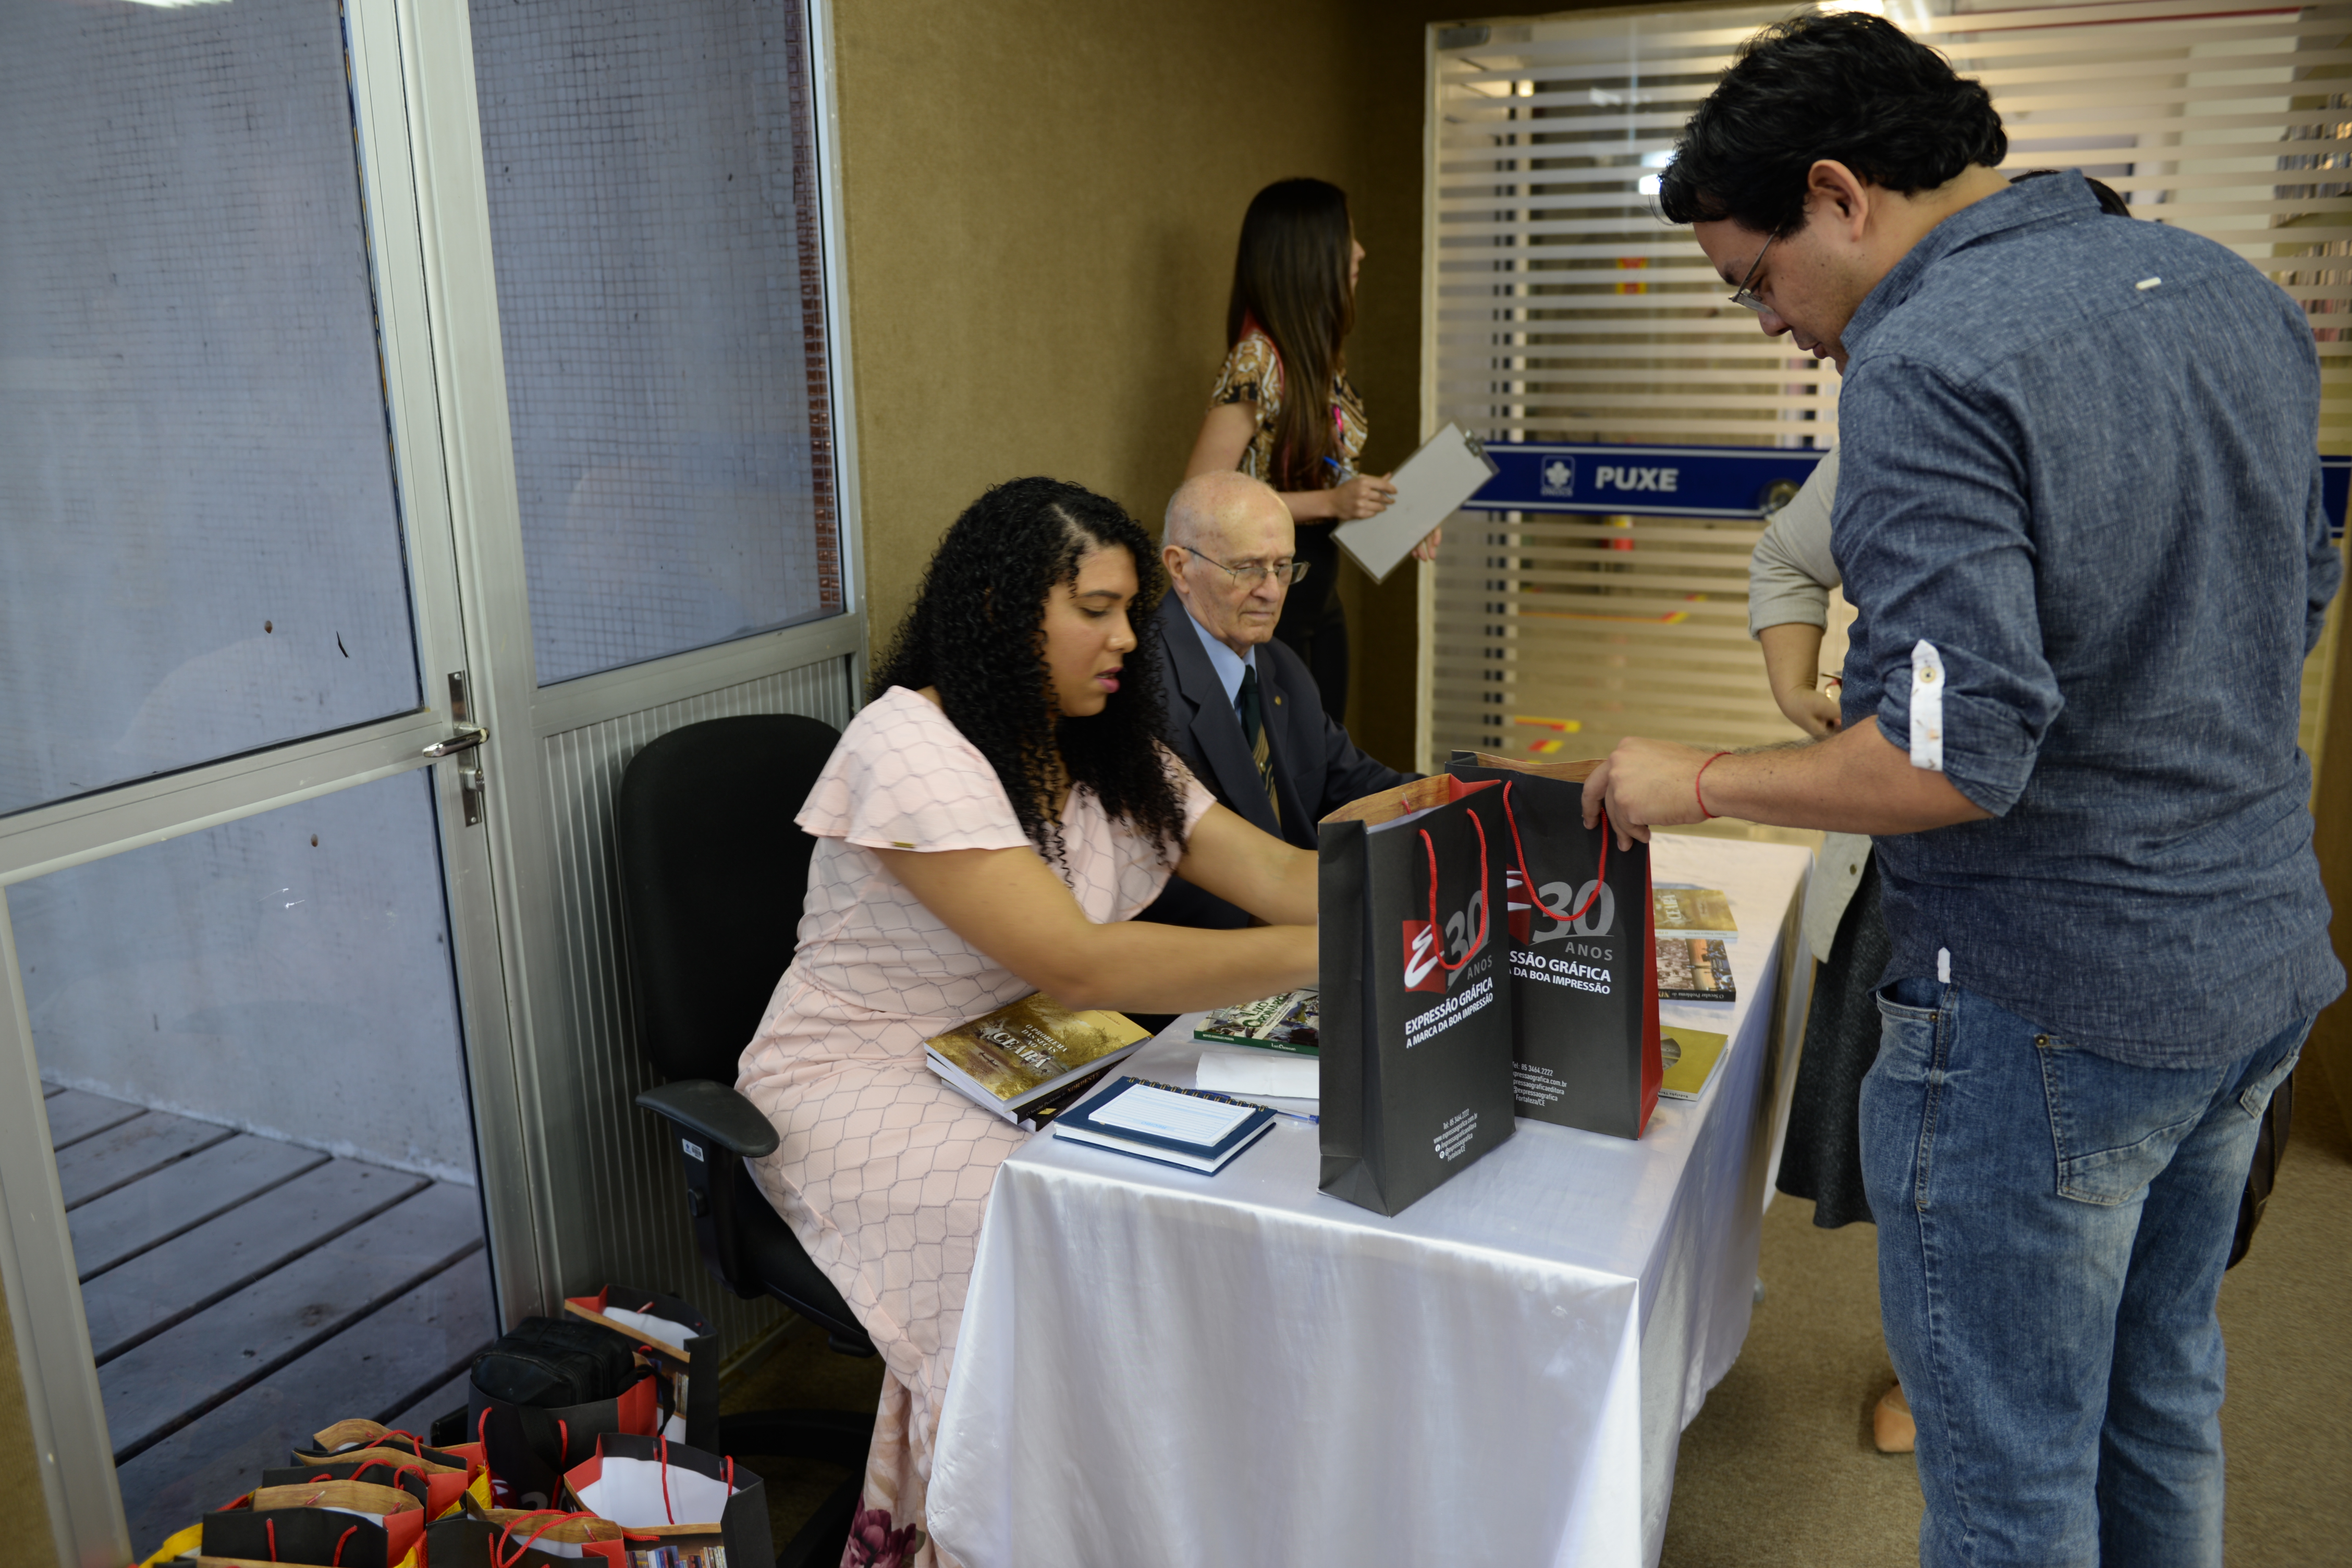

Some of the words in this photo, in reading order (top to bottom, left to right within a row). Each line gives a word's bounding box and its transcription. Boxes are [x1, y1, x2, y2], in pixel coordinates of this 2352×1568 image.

[1595, 465, 1679, 492] PUXE
[1532, 879, 1615, 942] 30
[1445, 890, 1490, 986] 30
[1565, 941, 1613, 961] ANOS
[1467, 955, 1492, 981] ANOS
[1513, 966, 1528, 978] DA
[1529, 970, 1551, 983] BOA
[1552, 975, 1610, 995] IMPRESSÃO
[1549, 959, 1611, 982] GRÁFICA
[1405, 998, 1459, 1035] EXPRESSÃO
[1459, 976, 1493, 1006] GRÁFICA
[1406, 1038, 1413, 1049] A
[1413, 1025, 1438, 1045] MARCA
[1438, 1020, 1448, 1033] DA
[1449, 1012, 1462, 1027] BOA
[1462, 993, 1493, 1019] IMPRESSÃO
[993, 1032, 1051, 1069] CEARÁ
[1021, 1029, 1037, 1039] DAS
[1034, 1036, 1058, 1053] SECAS
[1031, 1027, 1068, 1052] PROBLEMA
[1528, 1065, 1553, 1076] 3464.2222
[1031, 1104, 1044, 1114] Secular
[1044, 1095, 1061, 1106] Problema
[1068, 1071, 1100, 1093] NORDESTE
[1516, 1094, 1545, 1106] Fortaleza/CE
